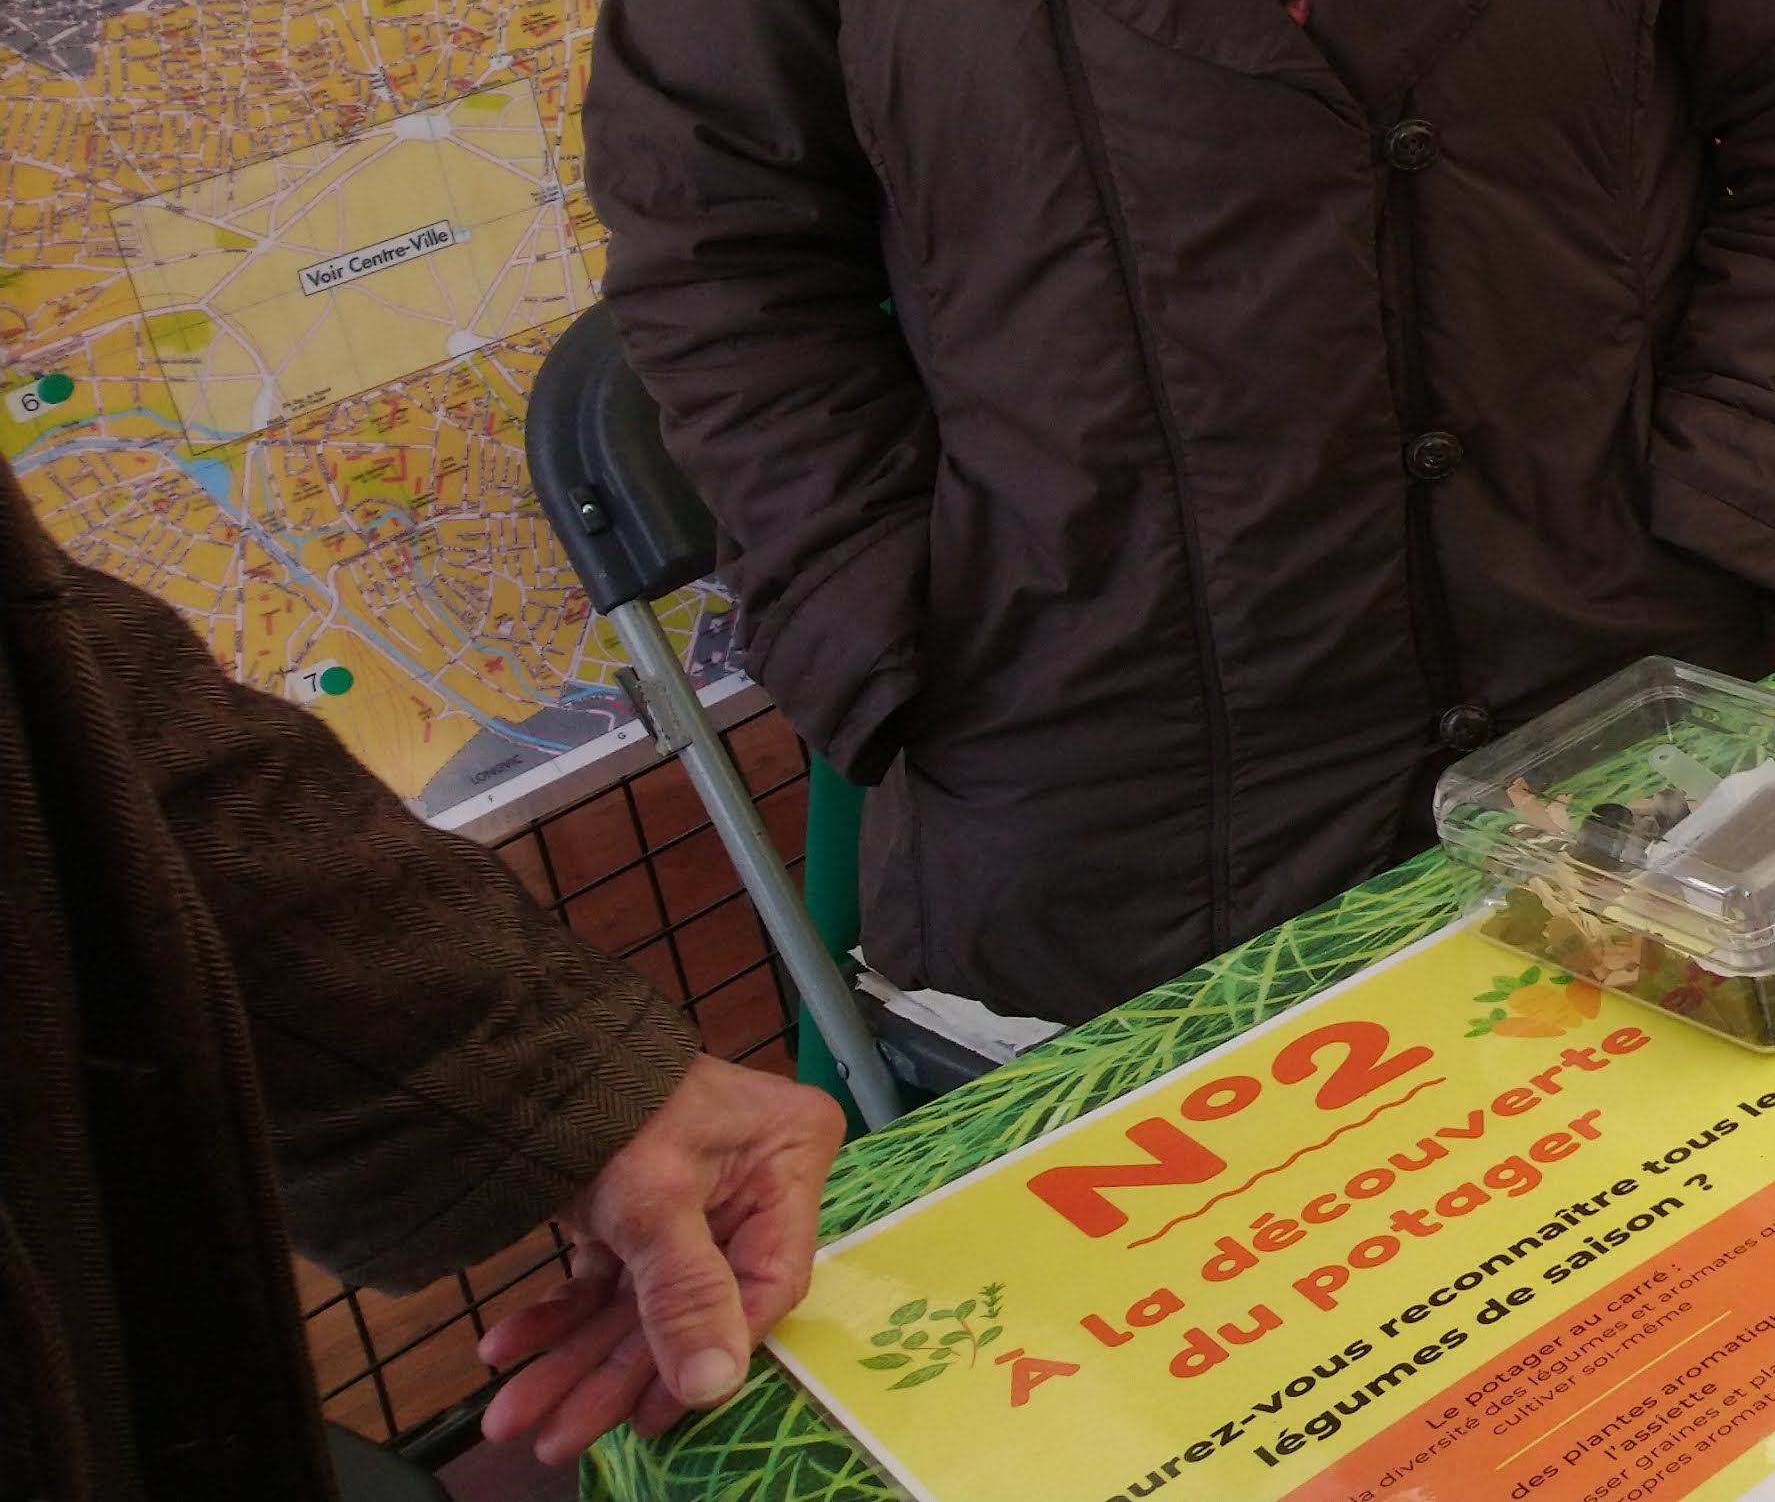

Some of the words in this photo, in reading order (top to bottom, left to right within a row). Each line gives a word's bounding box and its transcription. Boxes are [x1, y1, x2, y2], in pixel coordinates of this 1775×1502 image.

[306, 265, 345, 287] Voir
[349, 229, 449, 273] Centre-Ville
[22, 393, 39, 411] 6
[303, 673, 317, 693] 7
[995, 1348, 1080, 1407] À
[1080, 1288, 1185, 1347] la
[1200, 1026, 1650, 1282] découverte
[1168, 1303, 1284, 1378] du
[1291, 1108, 1602, 1312] potager
[1103, 1339, 1373, 1502] urez-vous
[1379, 1177, 1639, 1338] reconnaître
[1641, 1118, 1739, 1175] tous
[1253, 1327, 1468, 1467] légumes
[1476, 1285, 1536, 1325] de
[1543, 1196, 1685, 1285] saison
[1684, 1173, 1713, 1191] ?
[1379, 1416, 1480, 1488] diversité
[1485, 1385, 1527, 1416] des
[1530, 1319, 1628, 1386] légumes
[1631, 1303, 1656, 1321] et
[1658, 1237, 1758, 1304] aromates
[1426, 1406, 1460, 1430] Le
[1465, 1336, 1564, 1408] potager
[1569, 1314, 1601, 1337] au
[1607, 1268, 1670, 1313] carré
[1493, 1376, 1576, 1436] cultiver
[1581, 1300, 1692, 1376] soi-même
[1511, 1465, 1559, 1500] des
[1563, 1395, 1658, 1467] plantes
[1604, 1382, 1717, 1461] l'assiette
[1635, 1407, 1720, 1471] graines
[1722, 1389, 1747, 1407] et
